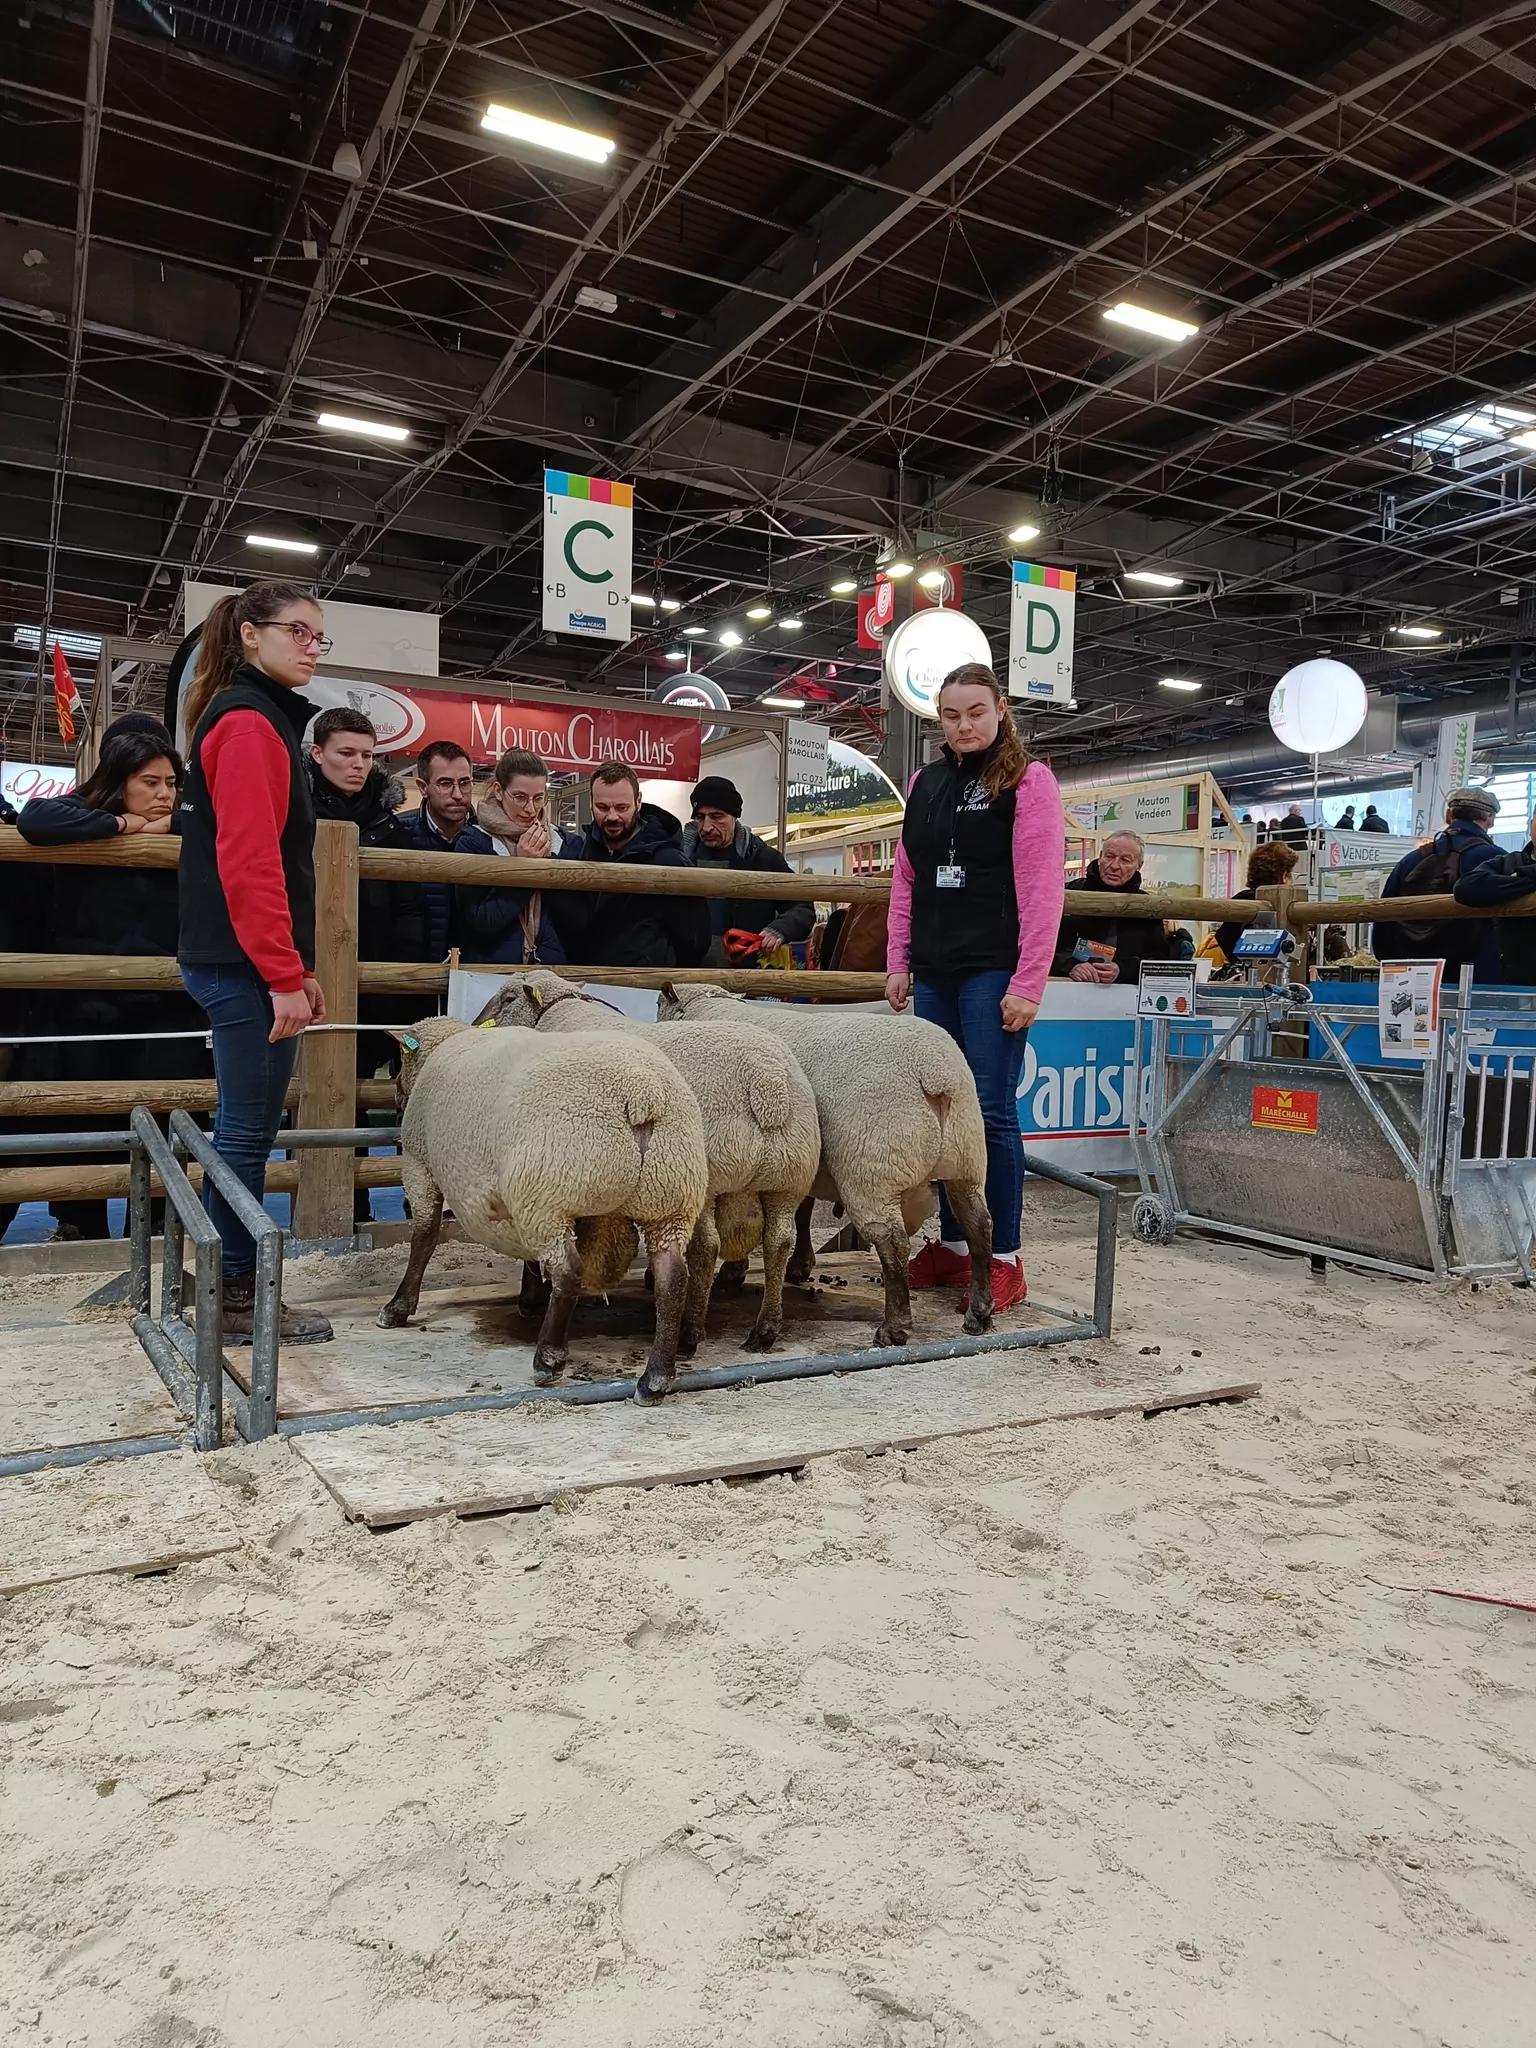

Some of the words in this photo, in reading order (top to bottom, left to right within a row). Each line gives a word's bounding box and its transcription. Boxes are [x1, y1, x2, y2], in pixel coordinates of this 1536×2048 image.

[563, 520, 615, 583] C
[556, 583, 566, 598] B
[607, 591, 619, 606] D
[1026, 600, 1061, 655] D
[1018, 656, 1027, 669] C
[1057, 662, 1063, 675] E
[794, 738, 825, 751] MOUTON
[788, 746, 825, 761] HAROLLAIS
[801, 772, 808, 782] C
[809, 775, 824, 785] 073
[1136, 796, 1170, 807] Mouton
[1134, 808, 1172, 820] Vendéen
[1341, 845, 1380, 862] VENDÉE
